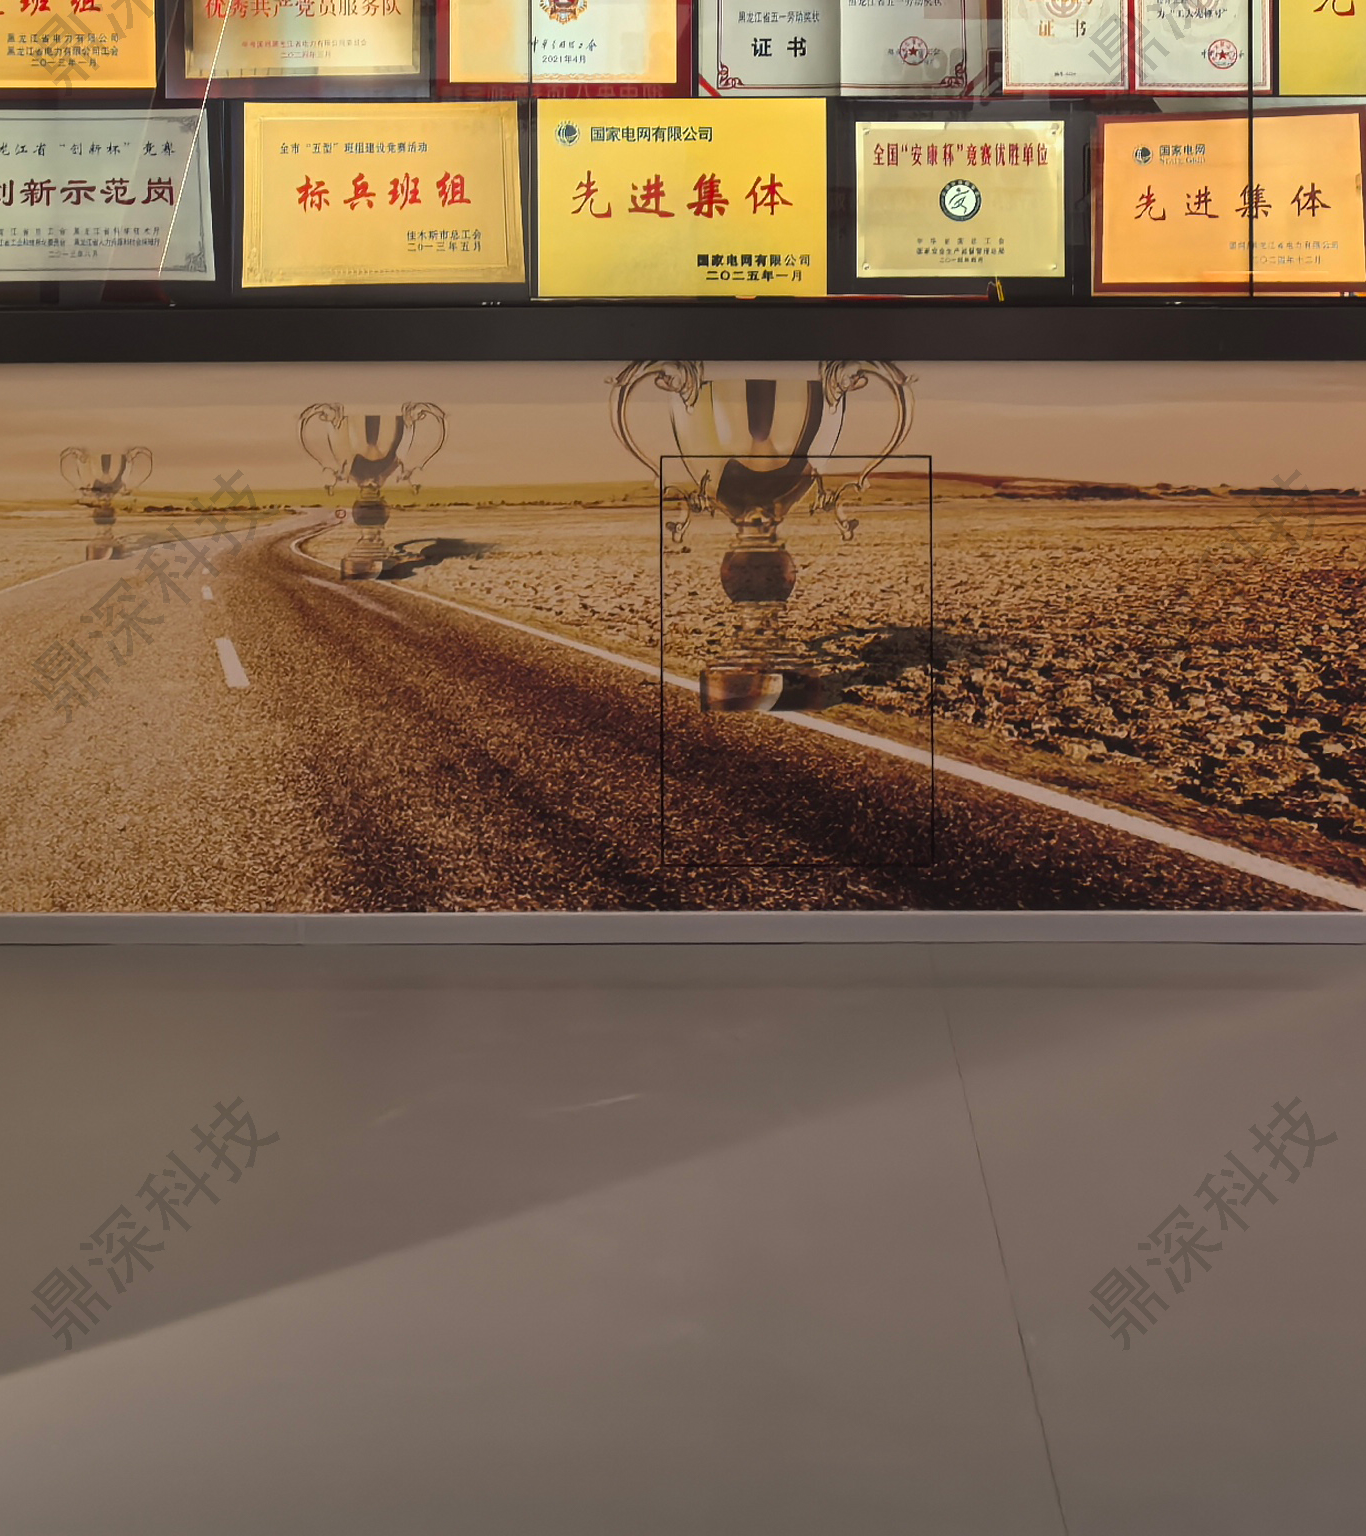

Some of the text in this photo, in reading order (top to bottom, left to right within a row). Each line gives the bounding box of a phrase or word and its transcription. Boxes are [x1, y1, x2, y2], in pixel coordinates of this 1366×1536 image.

[751, 36, 807, 58] 证书
[590, 126, 714, 143] 国家电网有限公司
[872, 142, 1049, 167] 全国“安康杯”竞赛优胜单位
[1159, 143, 1206, 156] 国家电网
[296, 170, 472, 213] 标兵班组
[571, 170, 793, 219] 先进集体
[1134, 182, 1332, 221] 先进集体
[406, 229, 482, 241] 佳木斯市总工会
[696, 253, 811, 268] 国家电网有限公司
